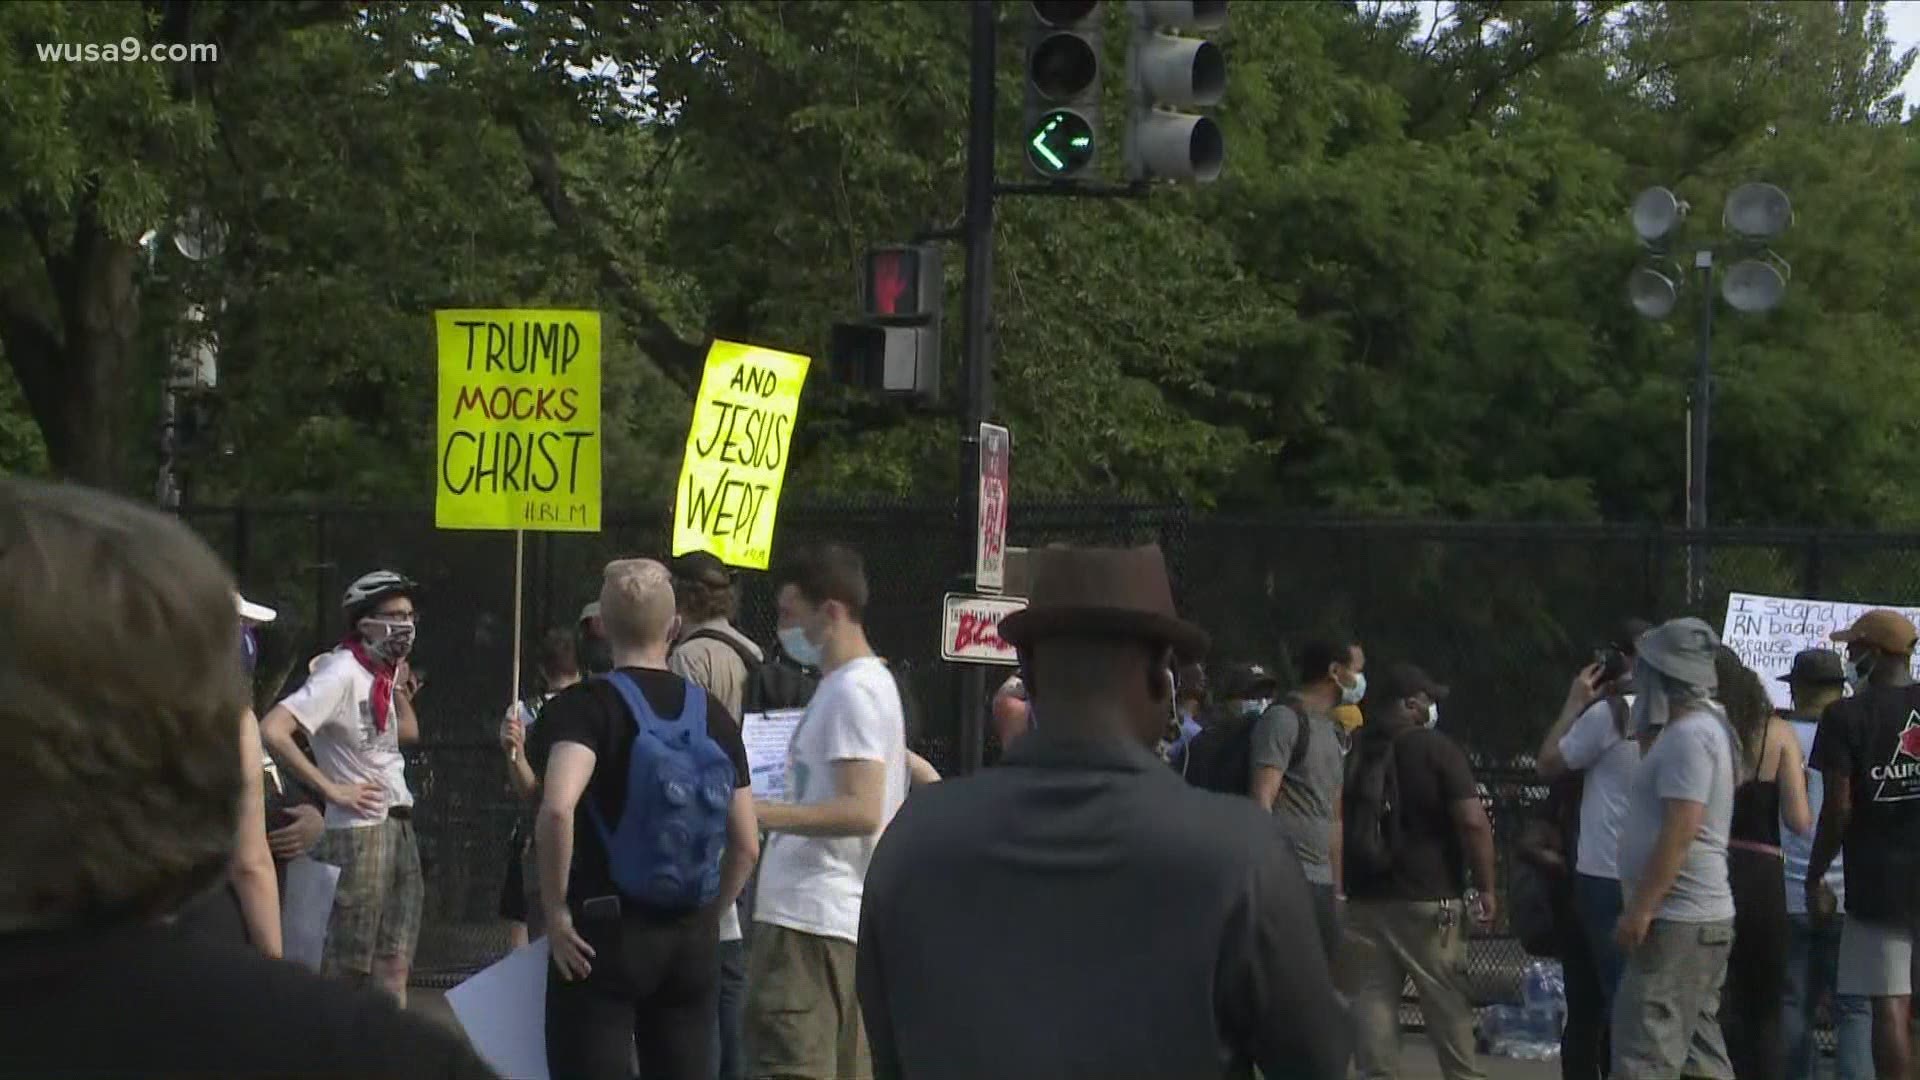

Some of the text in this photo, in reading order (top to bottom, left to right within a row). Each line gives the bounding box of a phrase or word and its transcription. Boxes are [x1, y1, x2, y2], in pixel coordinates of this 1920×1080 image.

[454, 320, 580, 375] TRUMP
[453, 385, 579, 422] MOCKS
[730, 363, 777, 398] AND
[696, 400, 788, 471] JESUS
[443, 431, 595, 495] CHRIST
[687, 468, 769, 544] WEPT
[1732, 597, 1754, 613] I
[1733, 614, 1826, 640] RN badge
